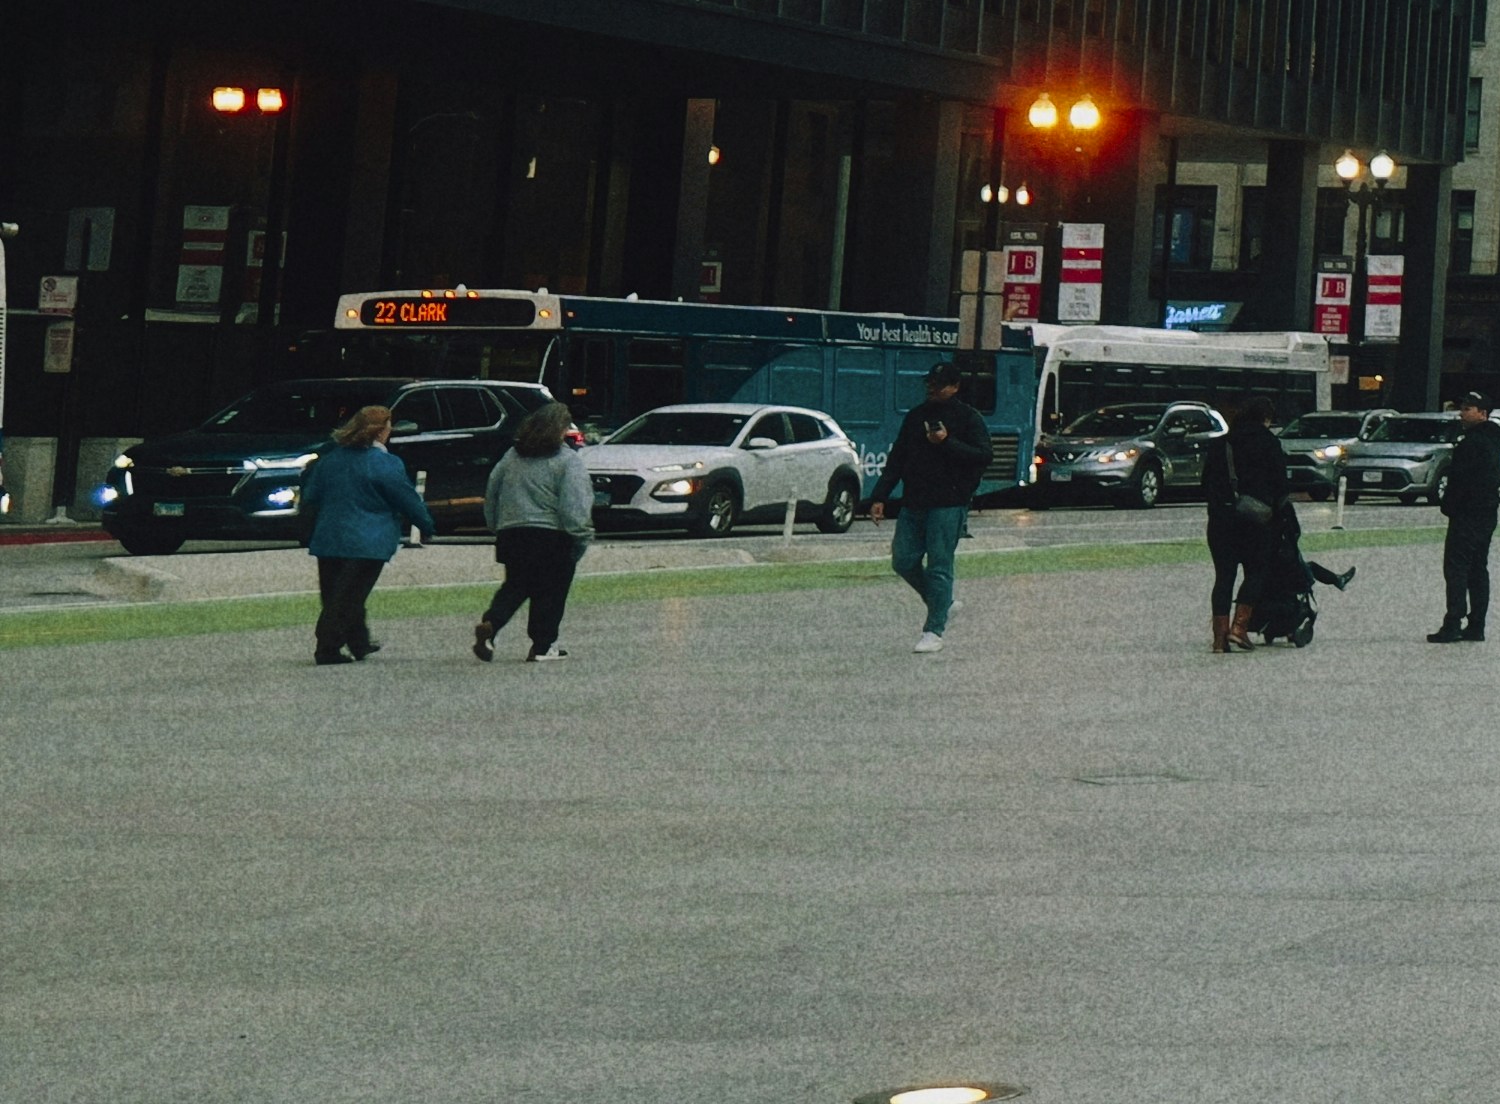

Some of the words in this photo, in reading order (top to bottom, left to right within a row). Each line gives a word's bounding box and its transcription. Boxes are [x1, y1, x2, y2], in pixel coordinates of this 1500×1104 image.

[374, 301, 397, 323] 22
[400, 302, 447, 322] CLARK
[857, 322, 880, 341] Your
[882, 322, 901, 342] best
[903, 323, 932, 343] health
[932, 327, 941, 343] is
[942, 332, 958, 344] our
